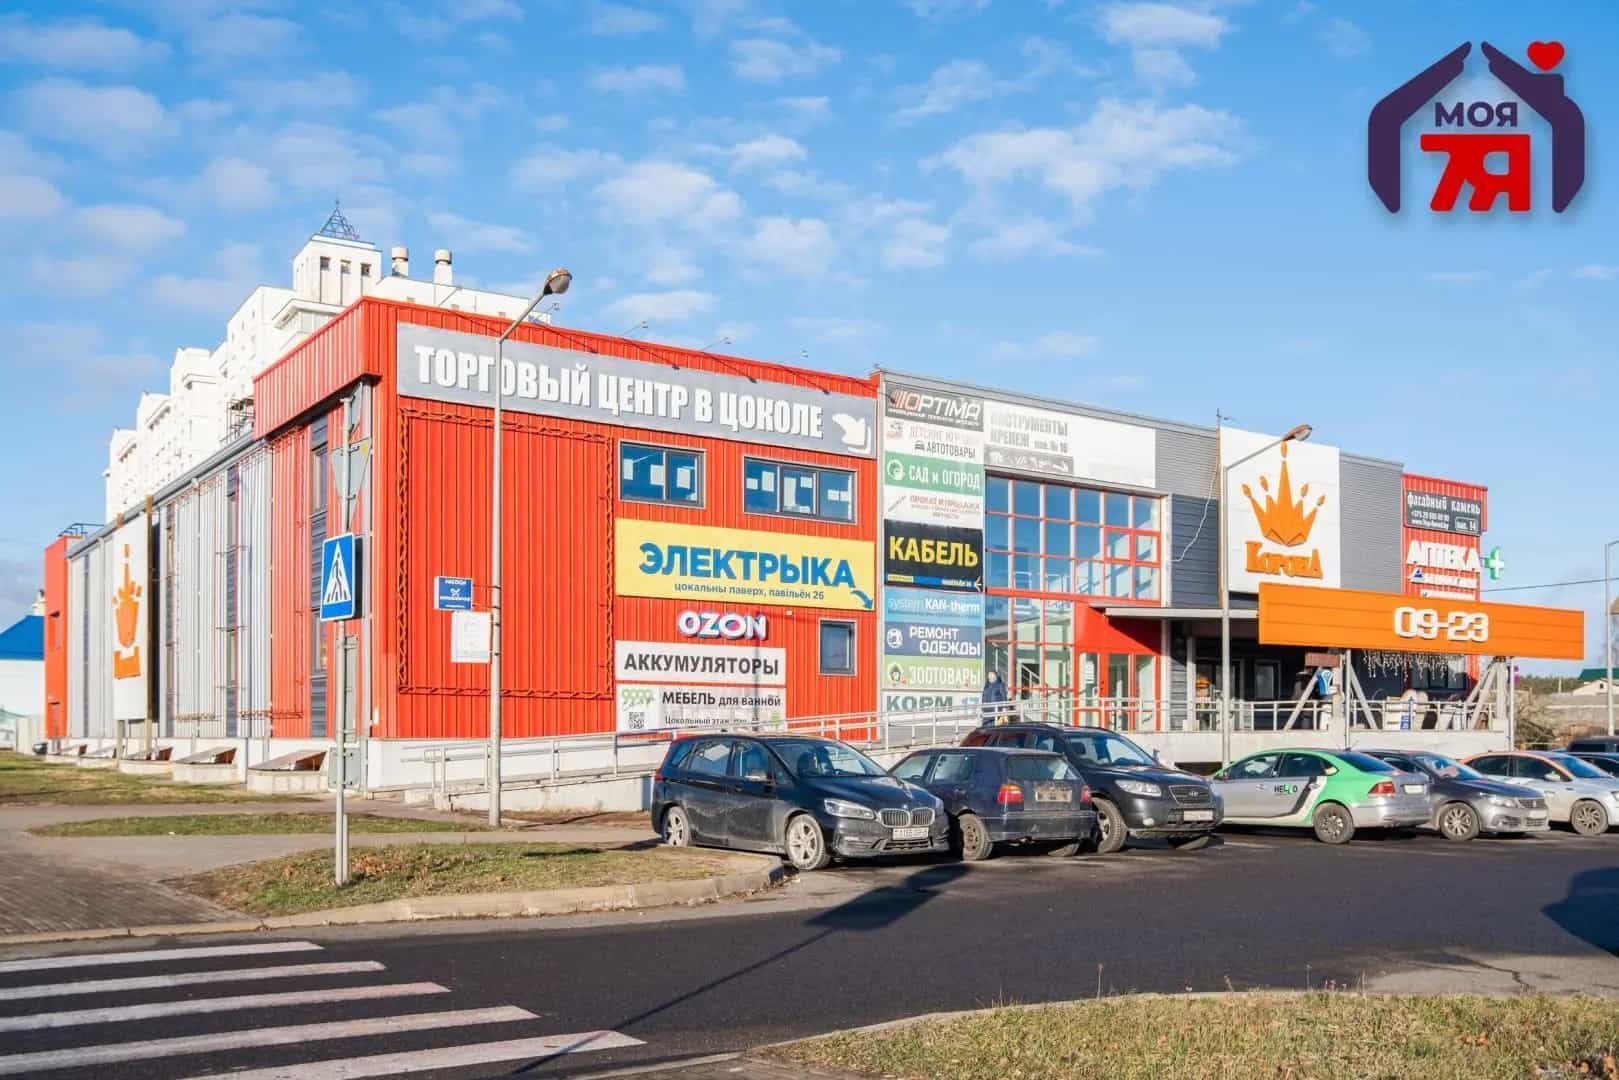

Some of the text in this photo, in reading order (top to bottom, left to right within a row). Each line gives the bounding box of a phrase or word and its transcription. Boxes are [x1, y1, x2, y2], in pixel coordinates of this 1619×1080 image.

[414, 345, 825, 439] ТОРГОВЫЙ ЦЕНТР В ЦОКОЛЕ
[904, 391, 982, 421] OPTIMA
[926, 441, 976, 459] АВТОТОВАРЫ
[908, 464, 929, 483] САД
[942, 470, 981, 490] ОГОРОД
[889, 536, 979, 567] КАБЕЛЬ
[1405, 540, 1481, 572] АПТЕКА
[639, 542, 856, 588] ЭЛЕКТРЫКА
[925, 598, 980, 613] KAN-therm
[678, 610, 768, 640] OZON
[909, 626, 960, 641] РЕМОНТ
[1393, 607, 1490, 642] 09-23
[919, 640, 981, 656] ОДЕЖДЫ
[624, 653, 779, 676] АККУМУЛЯТОРЫ
[909, 666, 981, 686] ЗООТОВАРЫ
[662, 692, 716, 705] МЕБЕЛЬ
[718, 696, 740, 707] для
[741, 694, 781, 706] ванной
[887, 695, 953, 713] КОРМ
